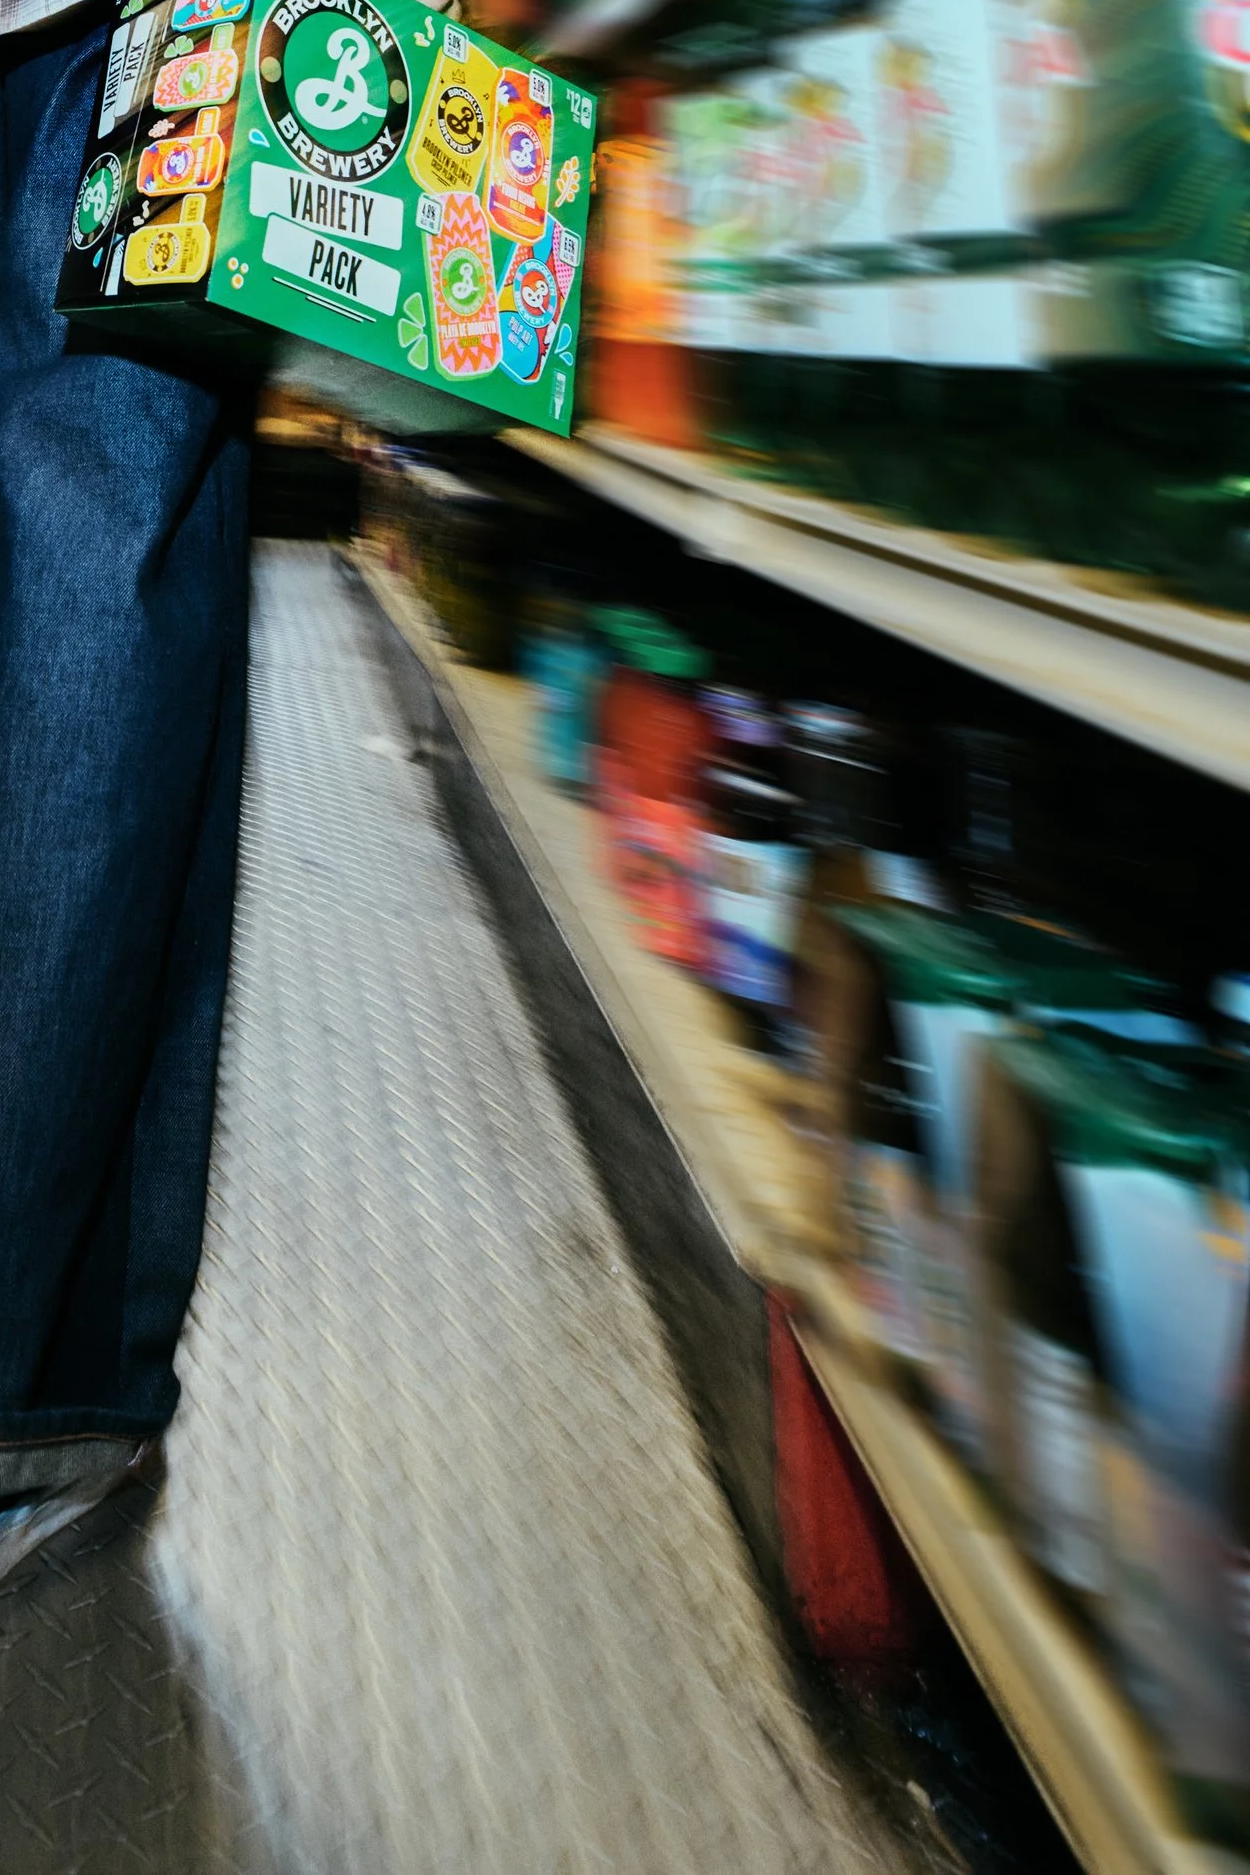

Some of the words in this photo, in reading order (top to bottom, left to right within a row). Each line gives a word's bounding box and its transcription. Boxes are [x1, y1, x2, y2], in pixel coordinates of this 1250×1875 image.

[103, 46, 123, 112] VARIETY
[123, 41, 145, 82] PACK
[447, 86, 483, 123] BROOKLYN
[277, 111, 396, 178] BREWERY
[438, 119, 474, 154] BREWERY
[72, 175, 90, 245] BROOKLYN
[289, 176, 374, 237] VARIETY
[308, 239, 363, 297] PACK
